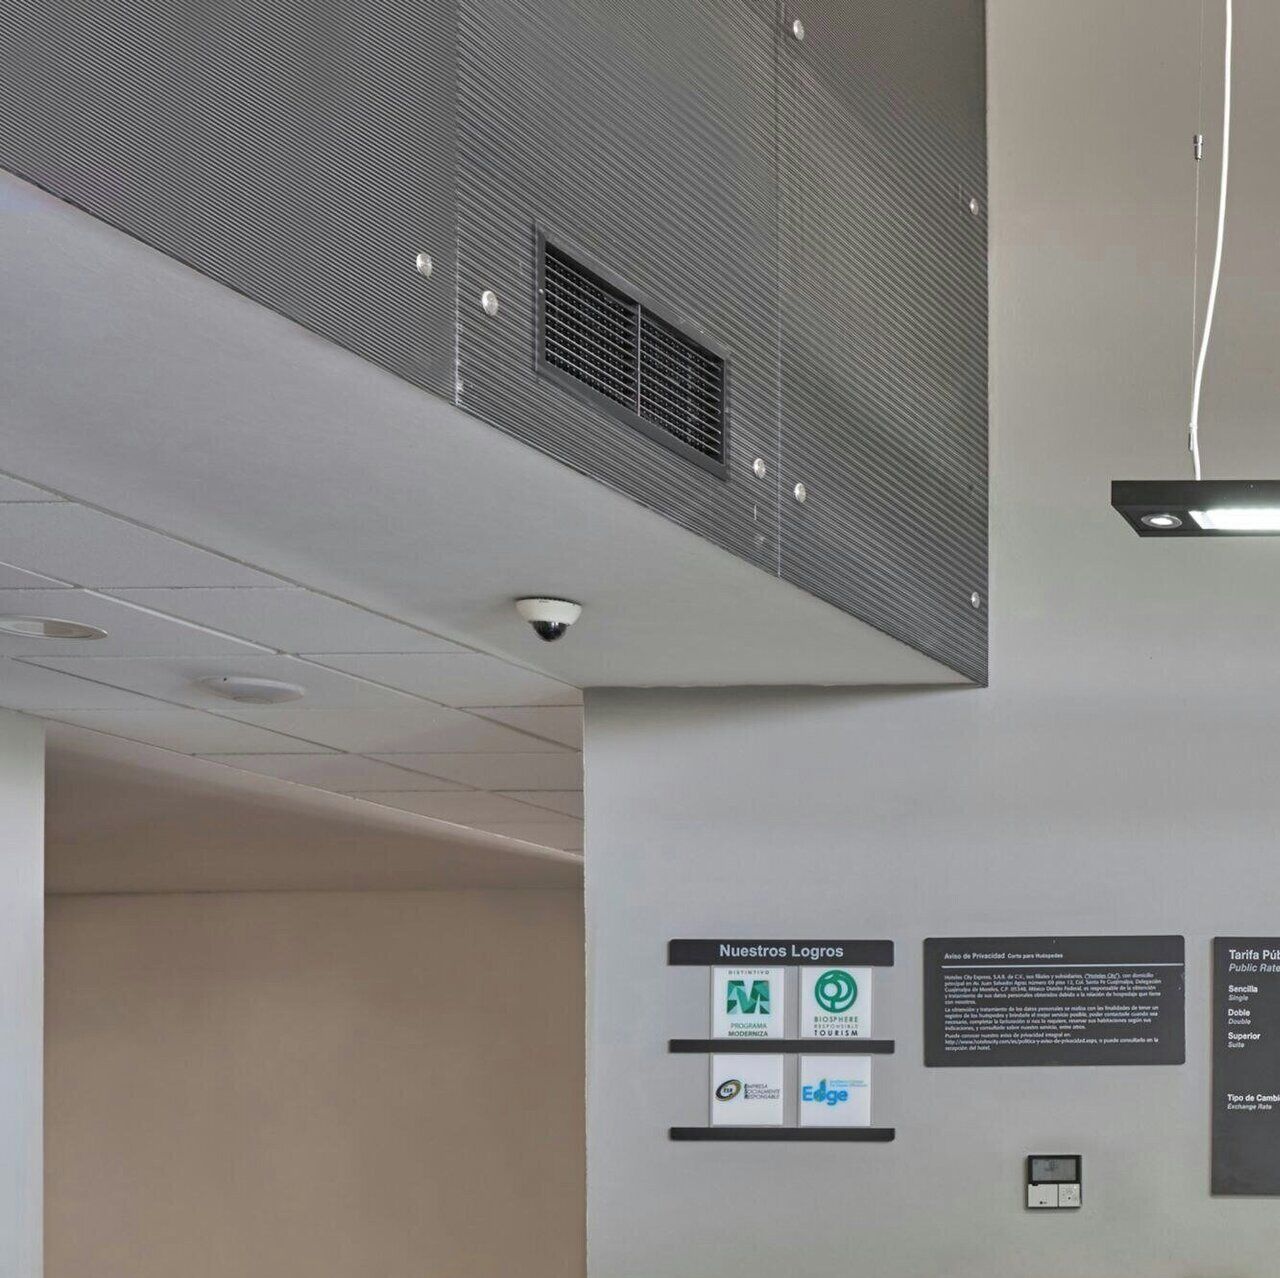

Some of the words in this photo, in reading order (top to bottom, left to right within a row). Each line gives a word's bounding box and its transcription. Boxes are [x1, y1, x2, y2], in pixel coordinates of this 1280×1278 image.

[720, 944, 787, 957] Nuestros
[792, 944, 844, 960] Logros
[1229, 949, 1259, 960] Tarifa
[1228, 963, 1258, 972] Public
[1228, 984, 1258, 993] Sencilla
[1228, 994, 1249, 1002] Single
[1228, 1008, 1250, 1017] Doble
[1228, 1032, 1261, 1041] Superior
[802, 1079, 848, 1106] Edge
[1227, 1094, 1244, 1102] Tipo
[1227, 1103, 1257, 1111] Exchange
